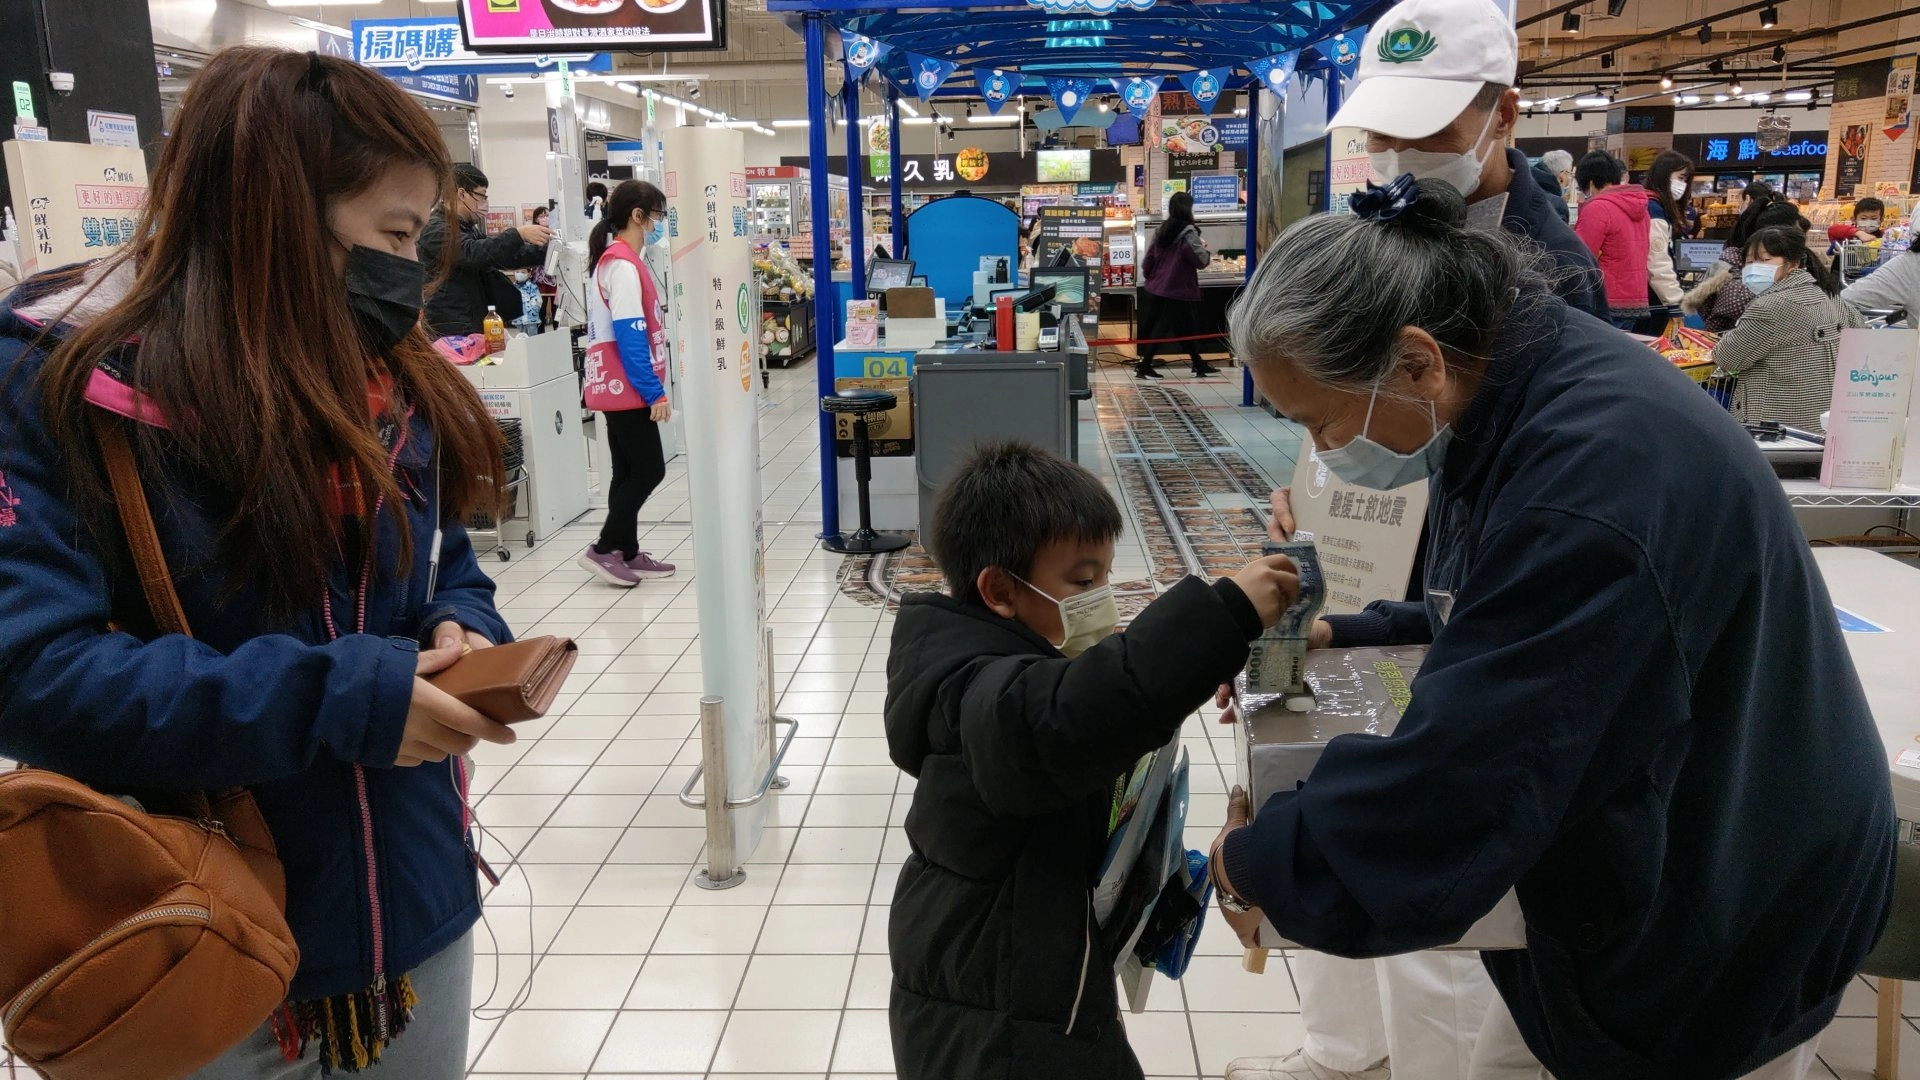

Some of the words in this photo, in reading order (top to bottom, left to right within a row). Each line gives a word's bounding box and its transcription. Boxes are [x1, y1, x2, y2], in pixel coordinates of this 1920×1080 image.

[363, 27, 459, 60] 掃碼購
[1162, 92, 1200, 110] 熟食
[1706, 138, 1760, 161] 海鮮
[757, 167, 776, 177] 特價
[875, 159, 954, 182] 久乳
[81, 217, 142, 248] 雙標章
[706, 201, 719, 243] 鮮乳坊
[34, 213, 53, 255] 鮮乳坊
[1112, 249, 1131, 260] 208
[712, 276, 728, 371] 特A級鮮乳
[868, 360, 903, 378] 04
[1849, 369, 1899, 387] Bonjour
[591, 383, 607, 395] APP
[1248, 645, 1264, 688] 1000
[378, 1003, 388, 1039] SUPERDRY
